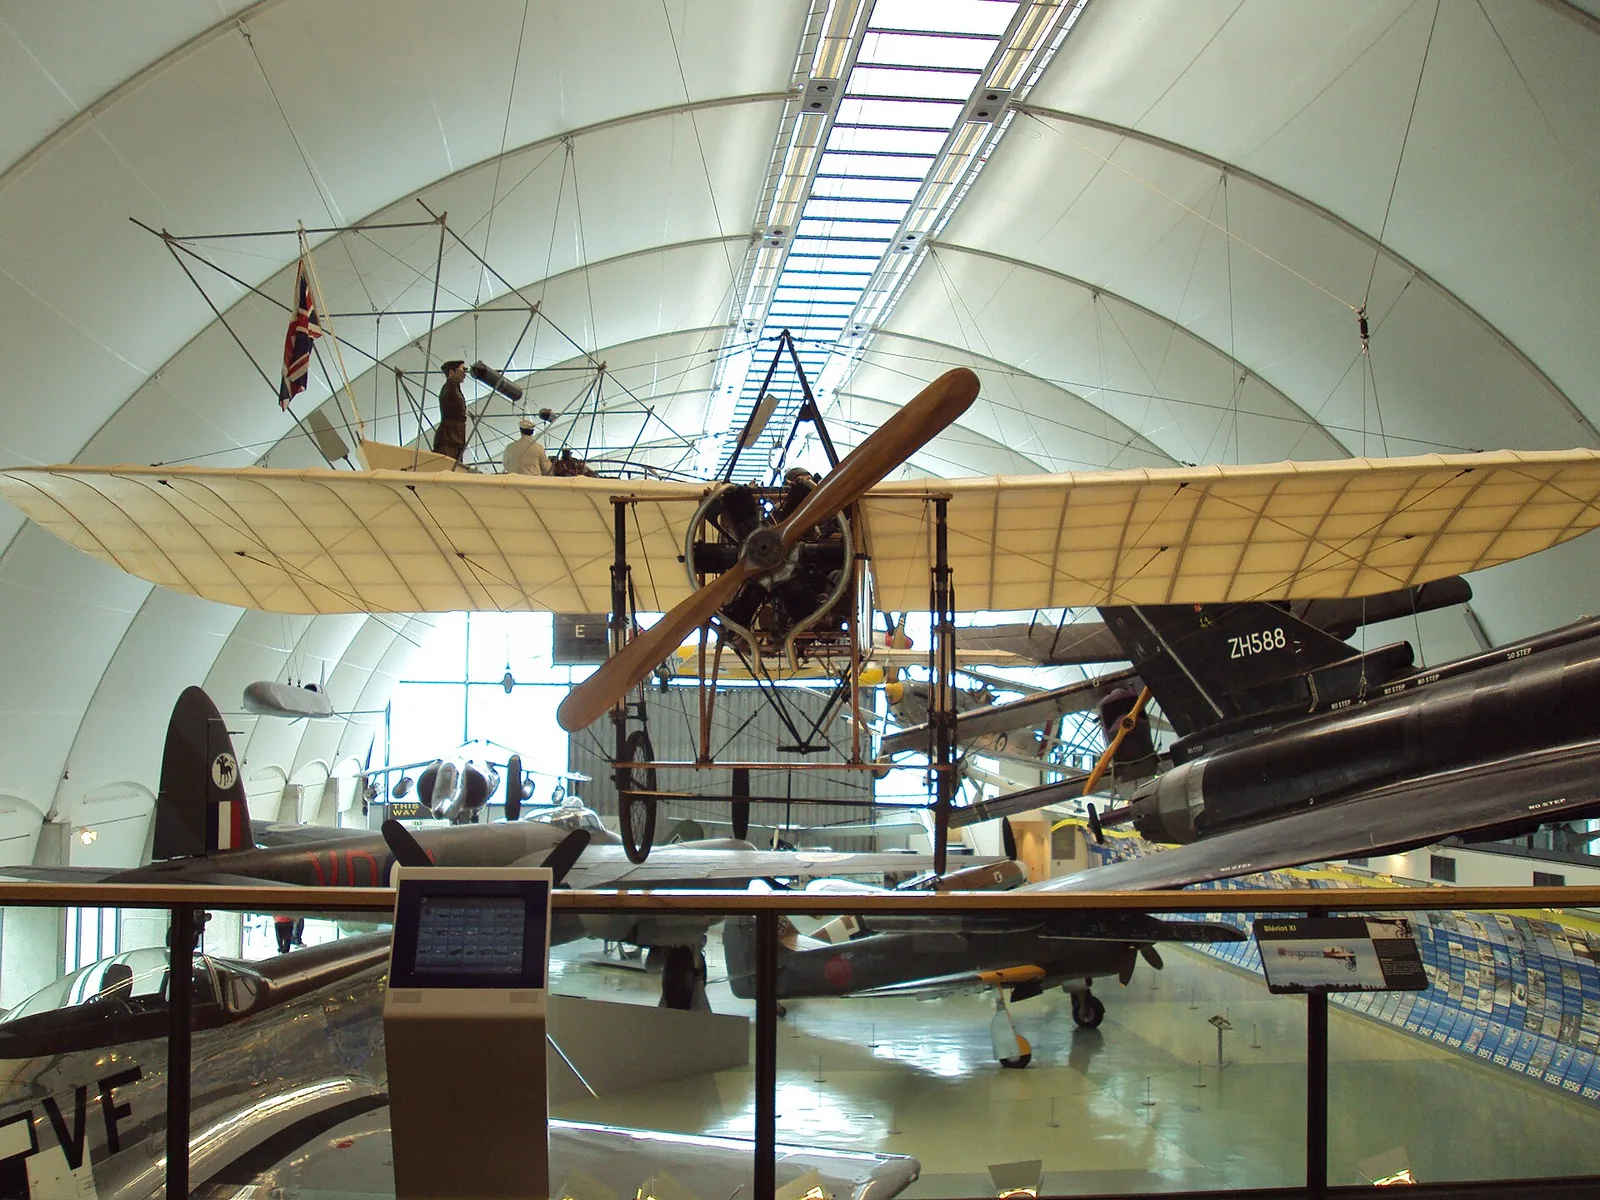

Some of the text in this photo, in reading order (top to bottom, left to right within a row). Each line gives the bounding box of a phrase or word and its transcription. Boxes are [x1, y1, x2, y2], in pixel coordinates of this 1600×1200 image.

[575, 624, 585, 638] E
[1227, 627, 1286, 659] ZH588
[1515, 647, 1531, 657] STEP
[1426, 674, 1440, 683] STEP
[1392, 683, 1406, 693] STEP
[1338, 699, 1352, 709] STEP
[1542, 798, 1566, 806] STEP
[1263, 924, 1288, 932] Blériot
[1477, 1048, 1493, 1060] 1951
[1493, 1054, 1509, 1066] 1952
[1509, 1060, 1526, 1072] 1953
[1526, 1066, 1543, 1078] 1954
[1544, 1072, 1562, 1086] 1955
[1562, 1079, 1581, 1093] 1956
[1581, 1086, 1600, 1100] 1957
[41, 1065, 143, 1171] VF
